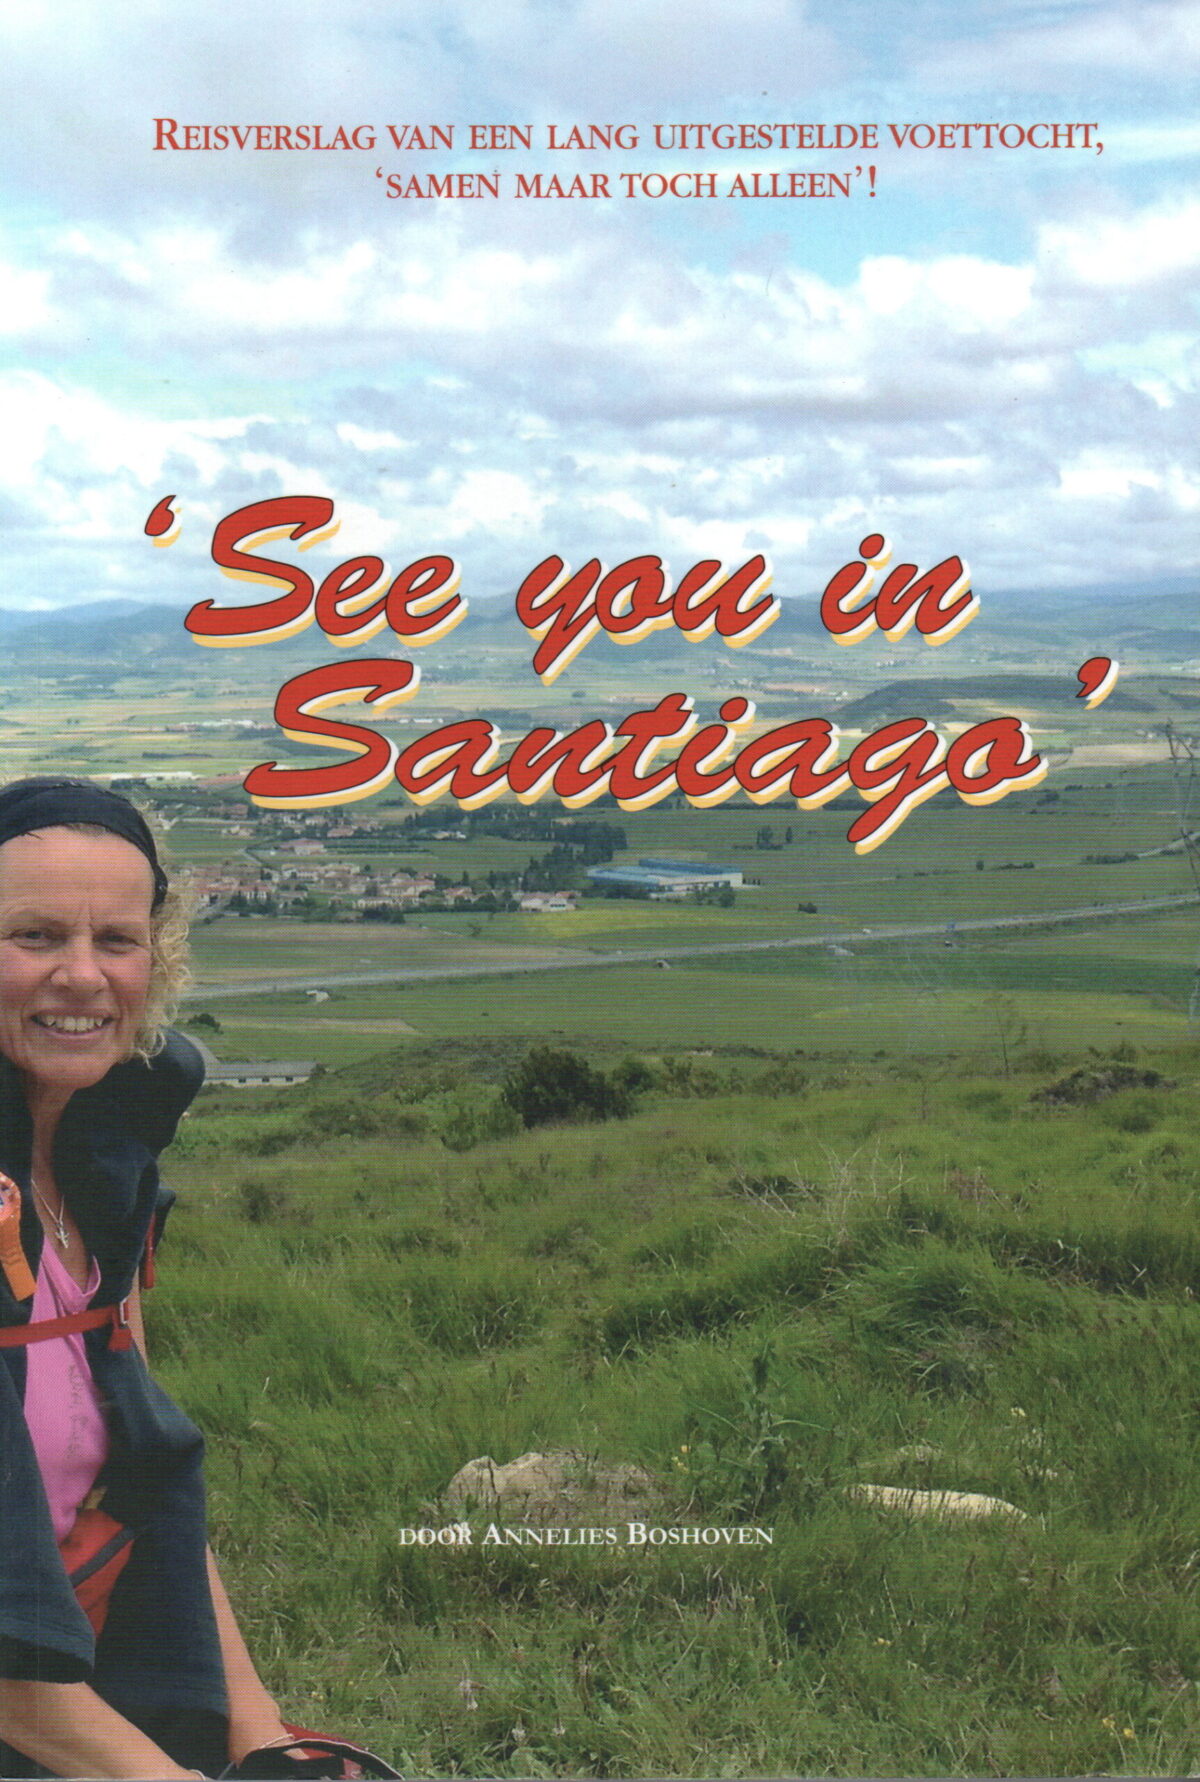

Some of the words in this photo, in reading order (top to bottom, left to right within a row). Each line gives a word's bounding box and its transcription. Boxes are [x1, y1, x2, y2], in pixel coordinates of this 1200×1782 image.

[154, 118, 376, 151] REISVERSLAG
[386, 125, 454, 151] VAN
[469, 125, 532, 150] EEN
[547, 125, 640, 151] LANG
[653, 124, 880, 150] UITGESTELDE
[889, 123, 1104, 154] VOETTOCHT,
[515, 173, 611, 199] MAAR
[620, 172, 719, 199] TOCH
[515, 553, 782, 685] you
[820, 532, 981, 648] in
